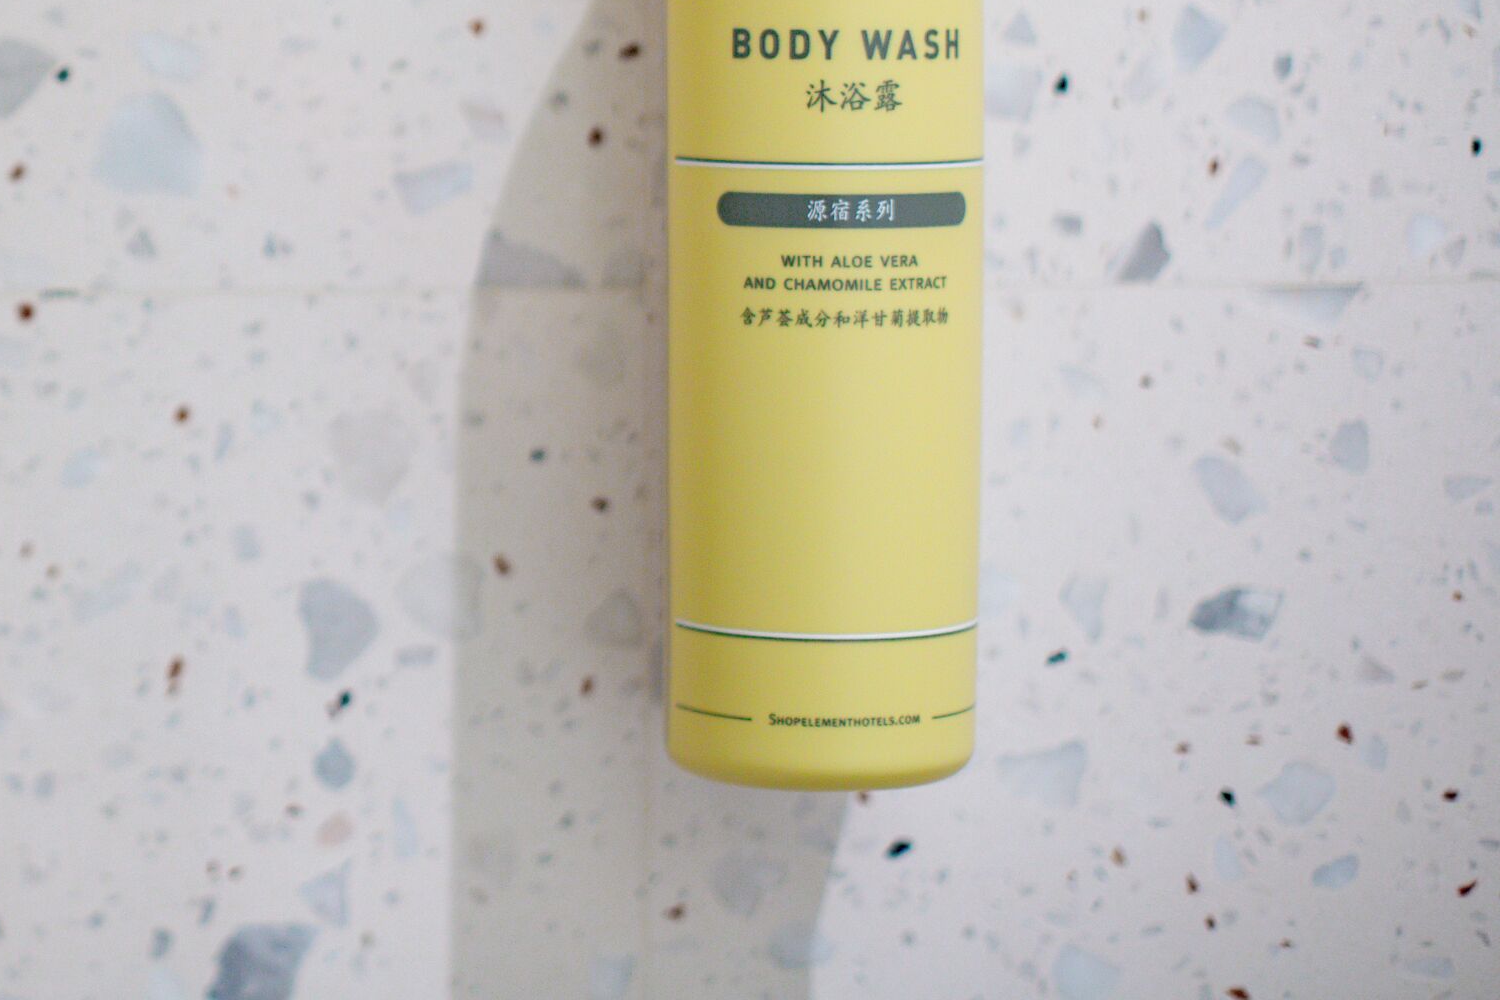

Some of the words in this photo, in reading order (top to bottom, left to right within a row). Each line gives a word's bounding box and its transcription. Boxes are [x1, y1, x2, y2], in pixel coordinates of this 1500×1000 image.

[731, 27, 840, 60] BODY
[861, 28, 960, 60] WASH
[805, 79, 903, 113] 沐浴露
[807, 198, 895, 222] 源宿系列
[781, 254, 823, 268] WITH
[831, 255, 872, 268] ALOE
[880, 254, 918, 268] VERA
[743, 276, 776, 290] AND
[783, 277, 882, 291] CHAMOMILE
[890, 276, 947, 290] EXTRACT
[740, 306, 948, 329] 含芦荟成分和洋甘菊提取物
